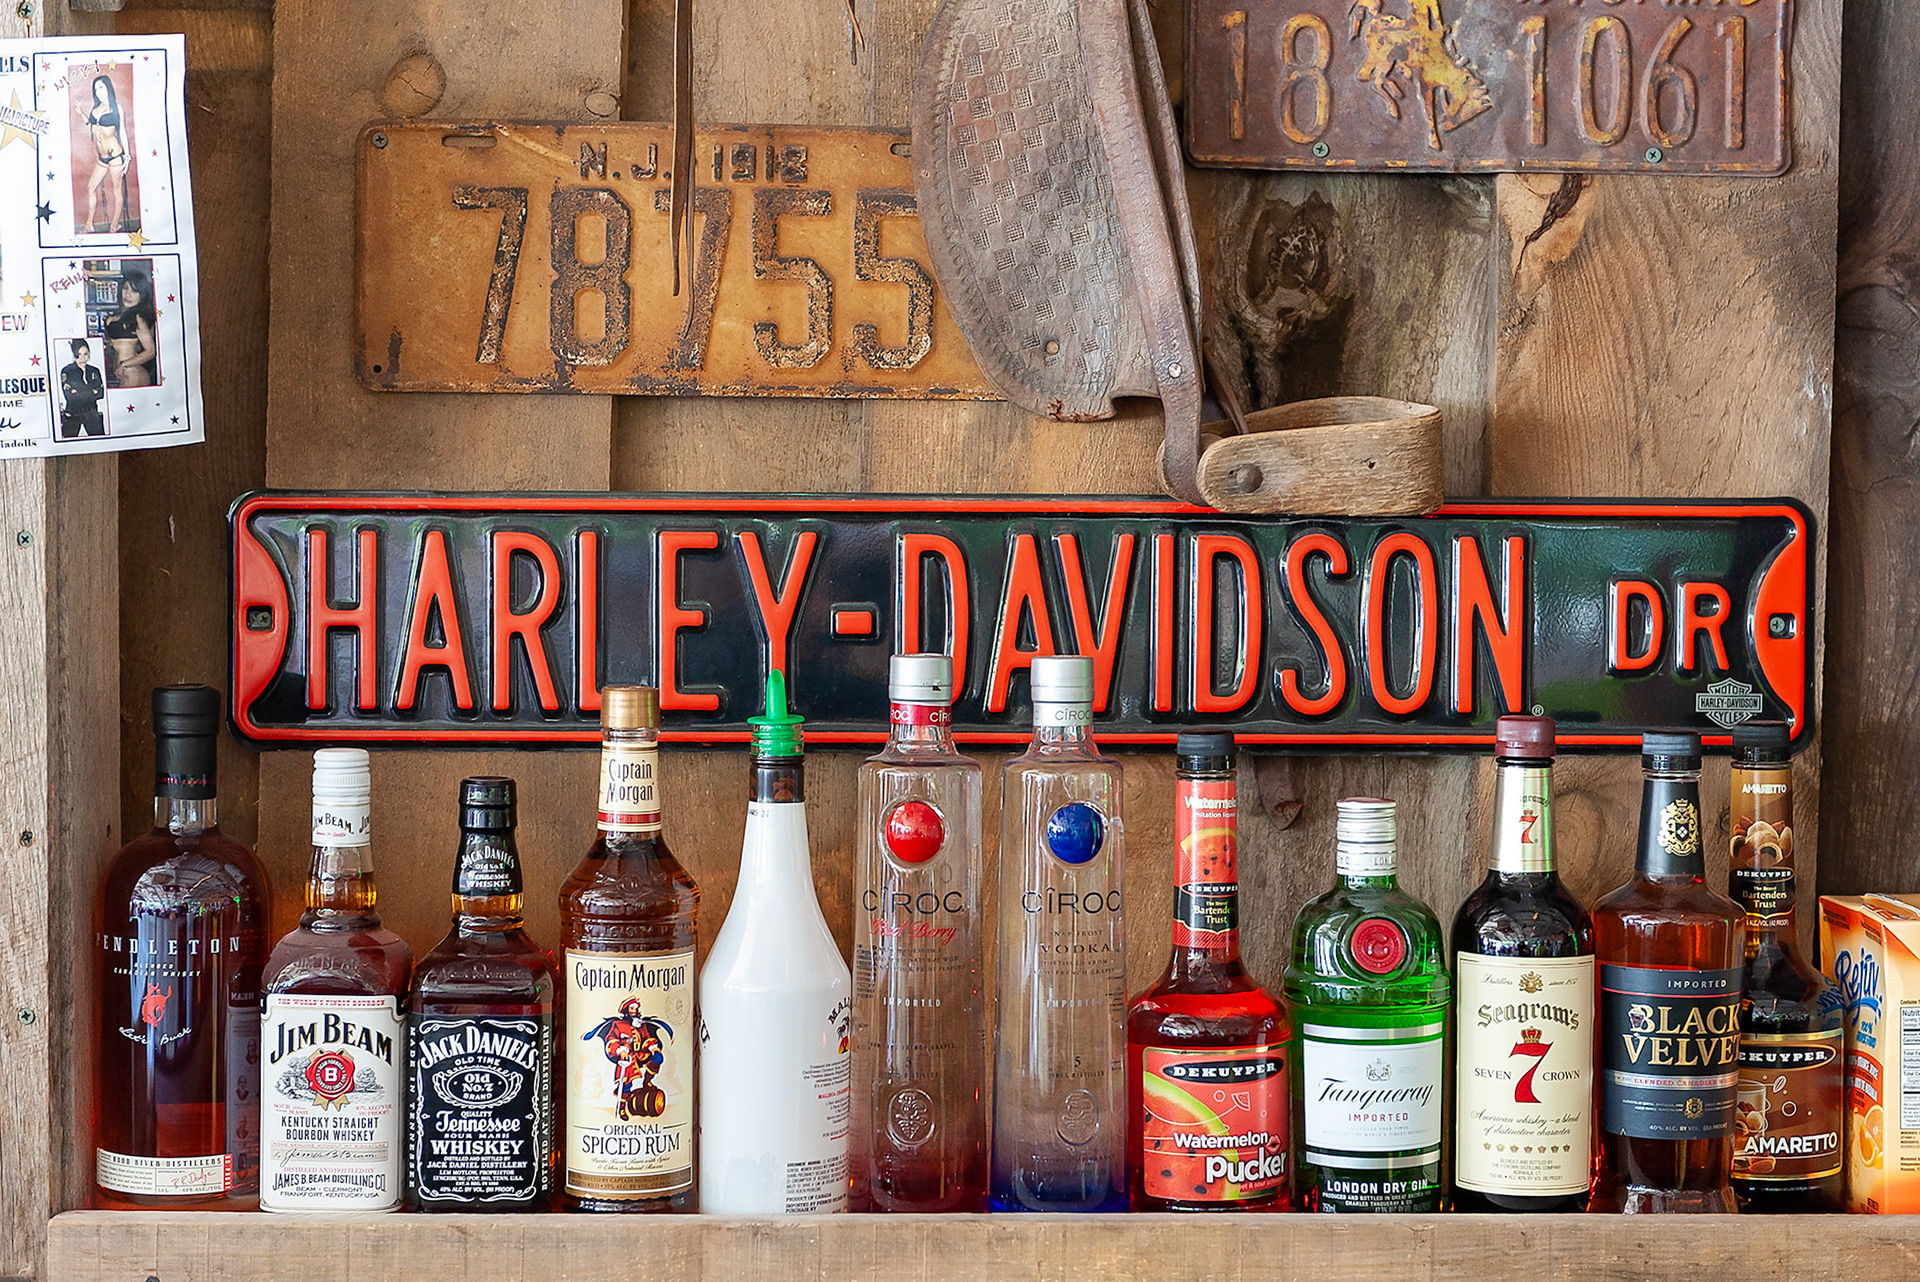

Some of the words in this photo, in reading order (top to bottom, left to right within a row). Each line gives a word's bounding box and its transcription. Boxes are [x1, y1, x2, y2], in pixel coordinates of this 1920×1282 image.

[1221, 10, 1333, 143] 18
[1518, 15, 1748, 149] 1061
[578, 142, 672, 181] N.J.
[1611, 580, 1732, 671] DR
[1713, 684, 1746, 695] MOTOR
[1700, 697, 1758, 708] HARLEY-DAVIDSON
[1742, 783, 1787, 795] AMARETTO
[1519, 815, 1539, 844] 7
[466, 879, 512, 888] WHISKEY
[1021, 885, 1122, 915] CÎROC
[1742, 890, 1788, 899] Bartenders
[1753, 899, 1777, 909] Trust
[1205, 914, 1228, 924] Trust
[906, 919, 958, 946] Berry
[1040, 942, 1111, 954] VODKA
[575, 960, 627, 991] Captain
[628, 963, 685, 993] Morgan
[1667, 979, 1727, 989] IMPORTED
[883, 996, 942, 1007] IMPORTED
[1477, 1002, 1580, 1030] Seagram's
[1627, 1002, 1742, 1034] BLACK
[159, 1026, 193, 1046] Buck
[270, 1021, 318, 1064] JIM
[322, 1012, 394, 1067] BEAM
[419, 1032, 462, 1069] JACK
[465, 1025, 540, 1071] DANIEL'S
[454, 1056, 475, 1066] OLD
[541, 1025, 549, 1093] DISTILLERY
[1074, 1055, 1081, 1068] 5
[1739, 1050, 1825, 1062] EKUYPER
[325, 1067, 339, 1082] B
[1173, 1062, 1274, 1078] DEKUYPER
[1474, 1067, 1512, 1080] SEVEN
[1542, 1069, 1580, 1082] CROWN
[1508, 1041, 1555, 1104] 7
[464, 1073, 491, 1083] Old
[1318, 1077, 1434, 1111] Tanqueray
[435, 1110, 521, 1133] Tennessee
[461, 1110, 493, 1119] QUALITY
[1348, 1112, 1409, 1122] IMPORTED
[1471, 1108, 1514, 1123] American
[281, 1116, 330, 1128] KENTUCKY
[332, 1116, 380, 1129] STRAIGHT
[603, 1123, 662, 1136] ORIGINAL
[286, 1128, 330, 1141] BOURBON
[332, 1129, 375, 1142] WHISKEY
[1173, 1131, 1269, 1150] Watermelon
[1743, 1131, 1838, 1154] AMARETTO
[430, 1139, 525, 1156] WHISKEY
[582, 1134, 641, 1156] SPICED
[645, 1132, 681, 1156] RUM
[427, 1161, 448, 1169] JACK
[448, 1161, 480, 1169] DANIEL
[480, 1161, 528, 1169] DISTILLERY
[272, 1172, 300, 1191] JAMES
[308, 1174, 331, 1184] BEAM
[332, 1174, 374, 1189] DISTILLING
[1326, 1179, 1378, 1194] LONDON
[1383, 1181, 1408, 1194] DRY
[1411, 1178, 1428, 1192] GIN
[1321, 1191, 1347, 1201] PRODUCED
